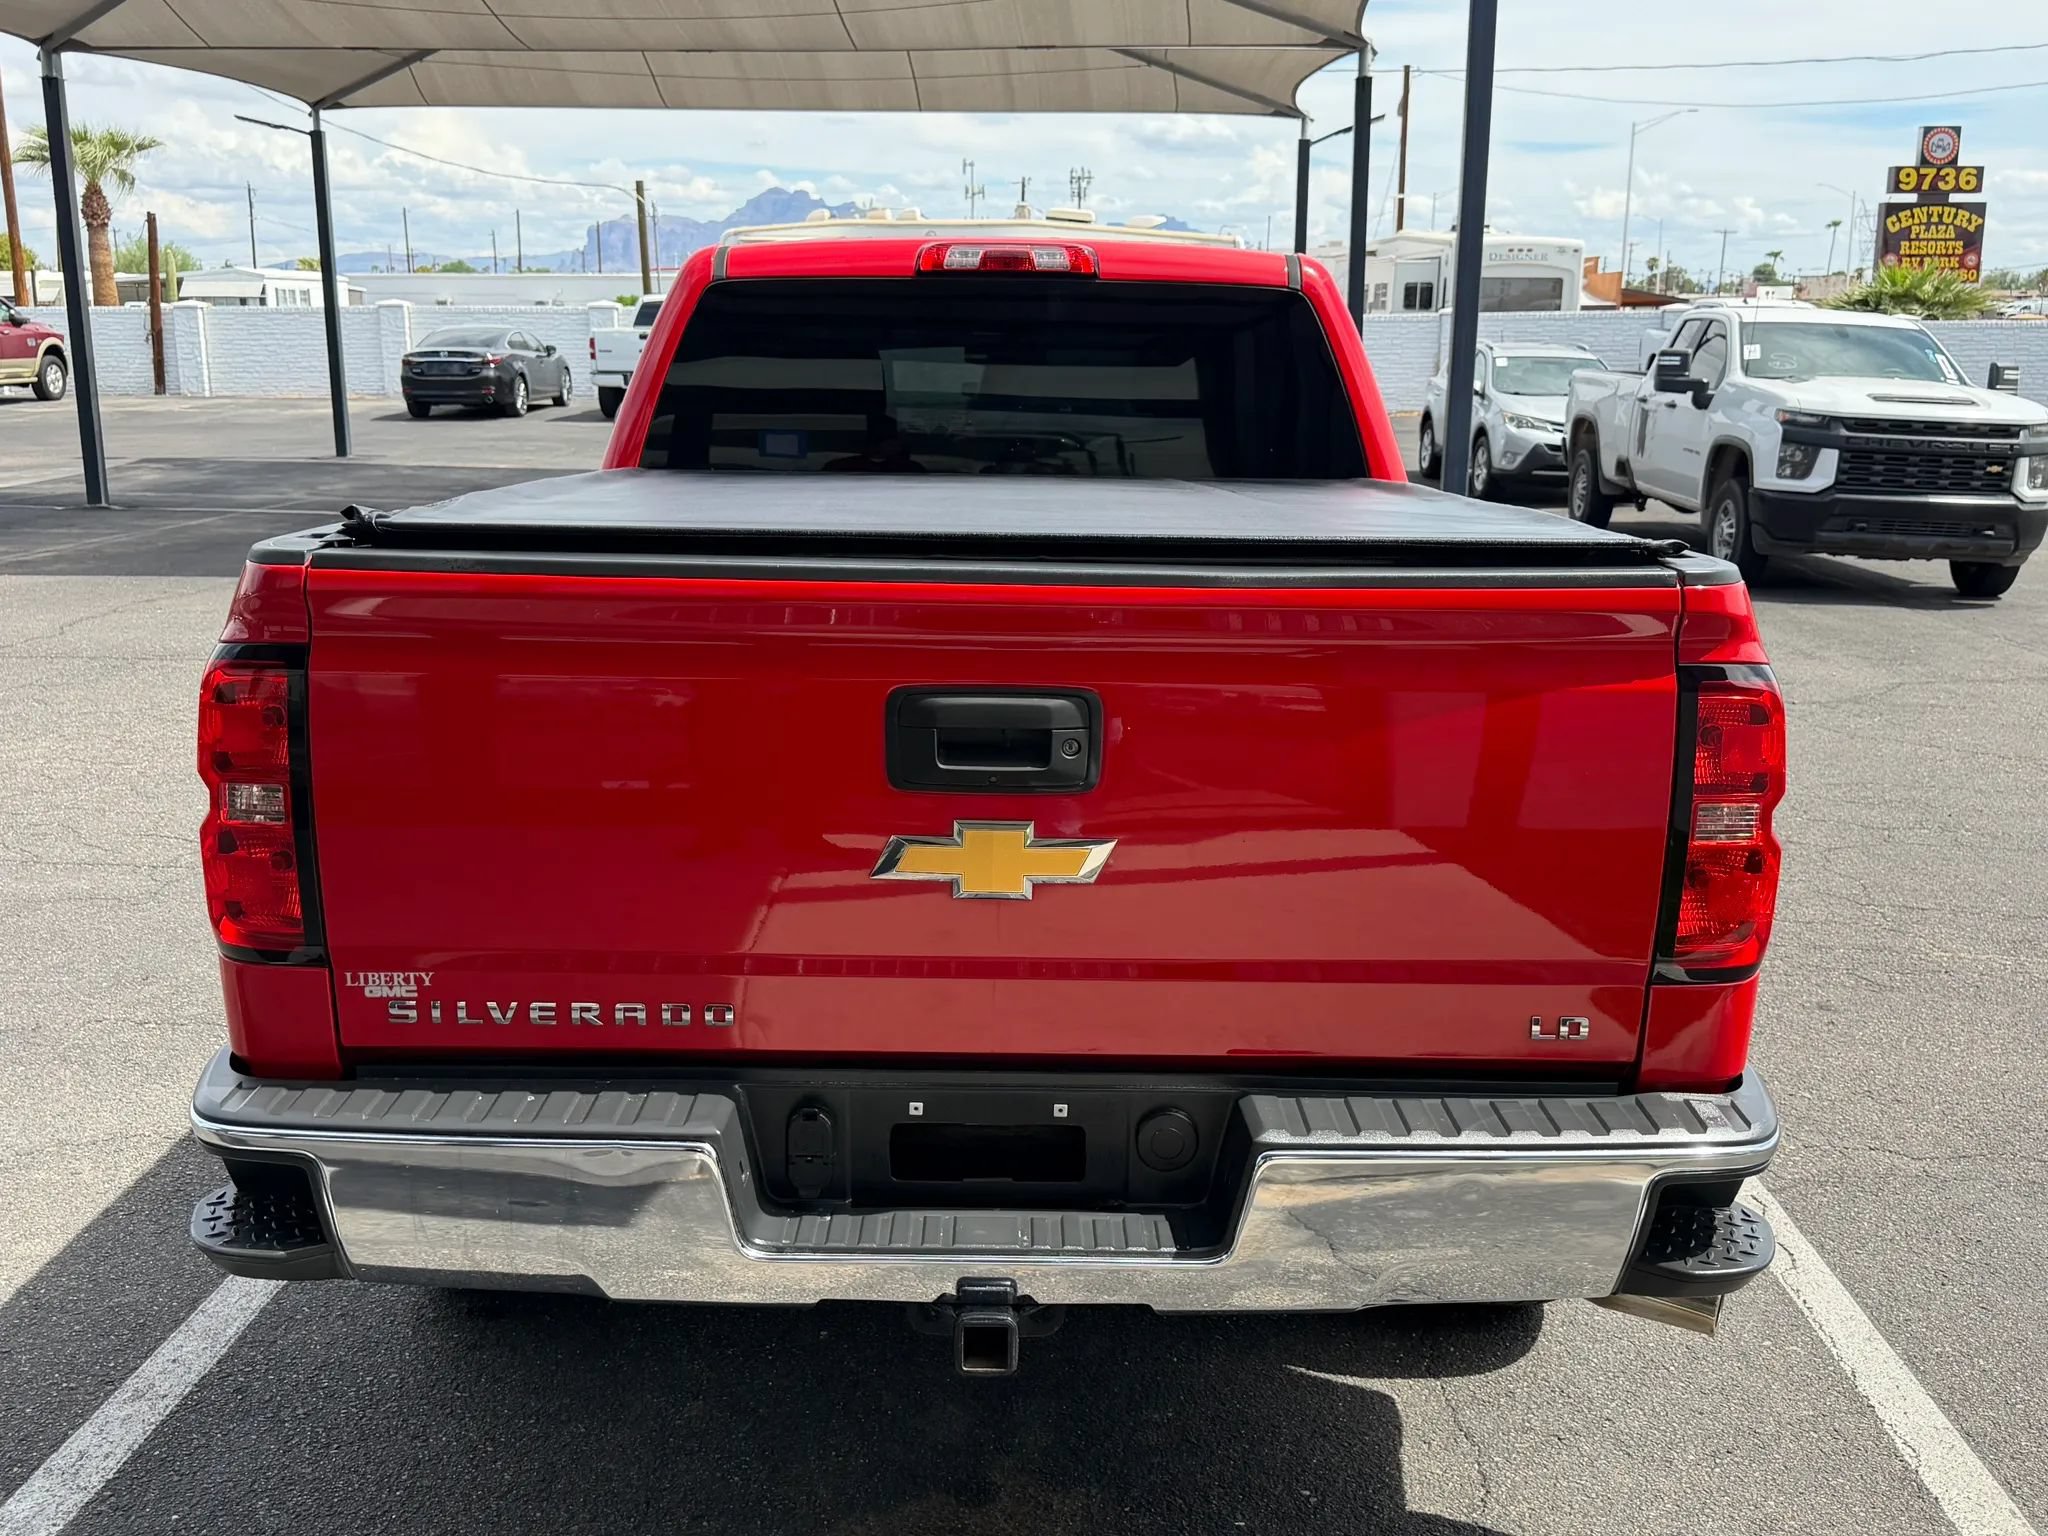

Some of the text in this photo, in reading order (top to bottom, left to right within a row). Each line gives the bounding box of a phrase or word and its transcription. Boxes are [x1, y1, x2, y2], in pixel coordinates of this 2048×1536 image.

[1898, 167, 1978, 192] 9736
[1886, 205, 1984, 234] CENTURY
[1910, 225, 1956, 239] PLAZA
[1900, 240, 1964, 255] RESORTS
[1489, 252, 1549, 262] DESIGNER
[1845, 435, 2020, 454] CHEVROLET
[344, 971, 435, 987] LIBERTY
[364, 985, 418, 998] GMC
[388, 1000, 735, 1026] SILVERADO
[1530, 1015, 1590, 1041] LD
